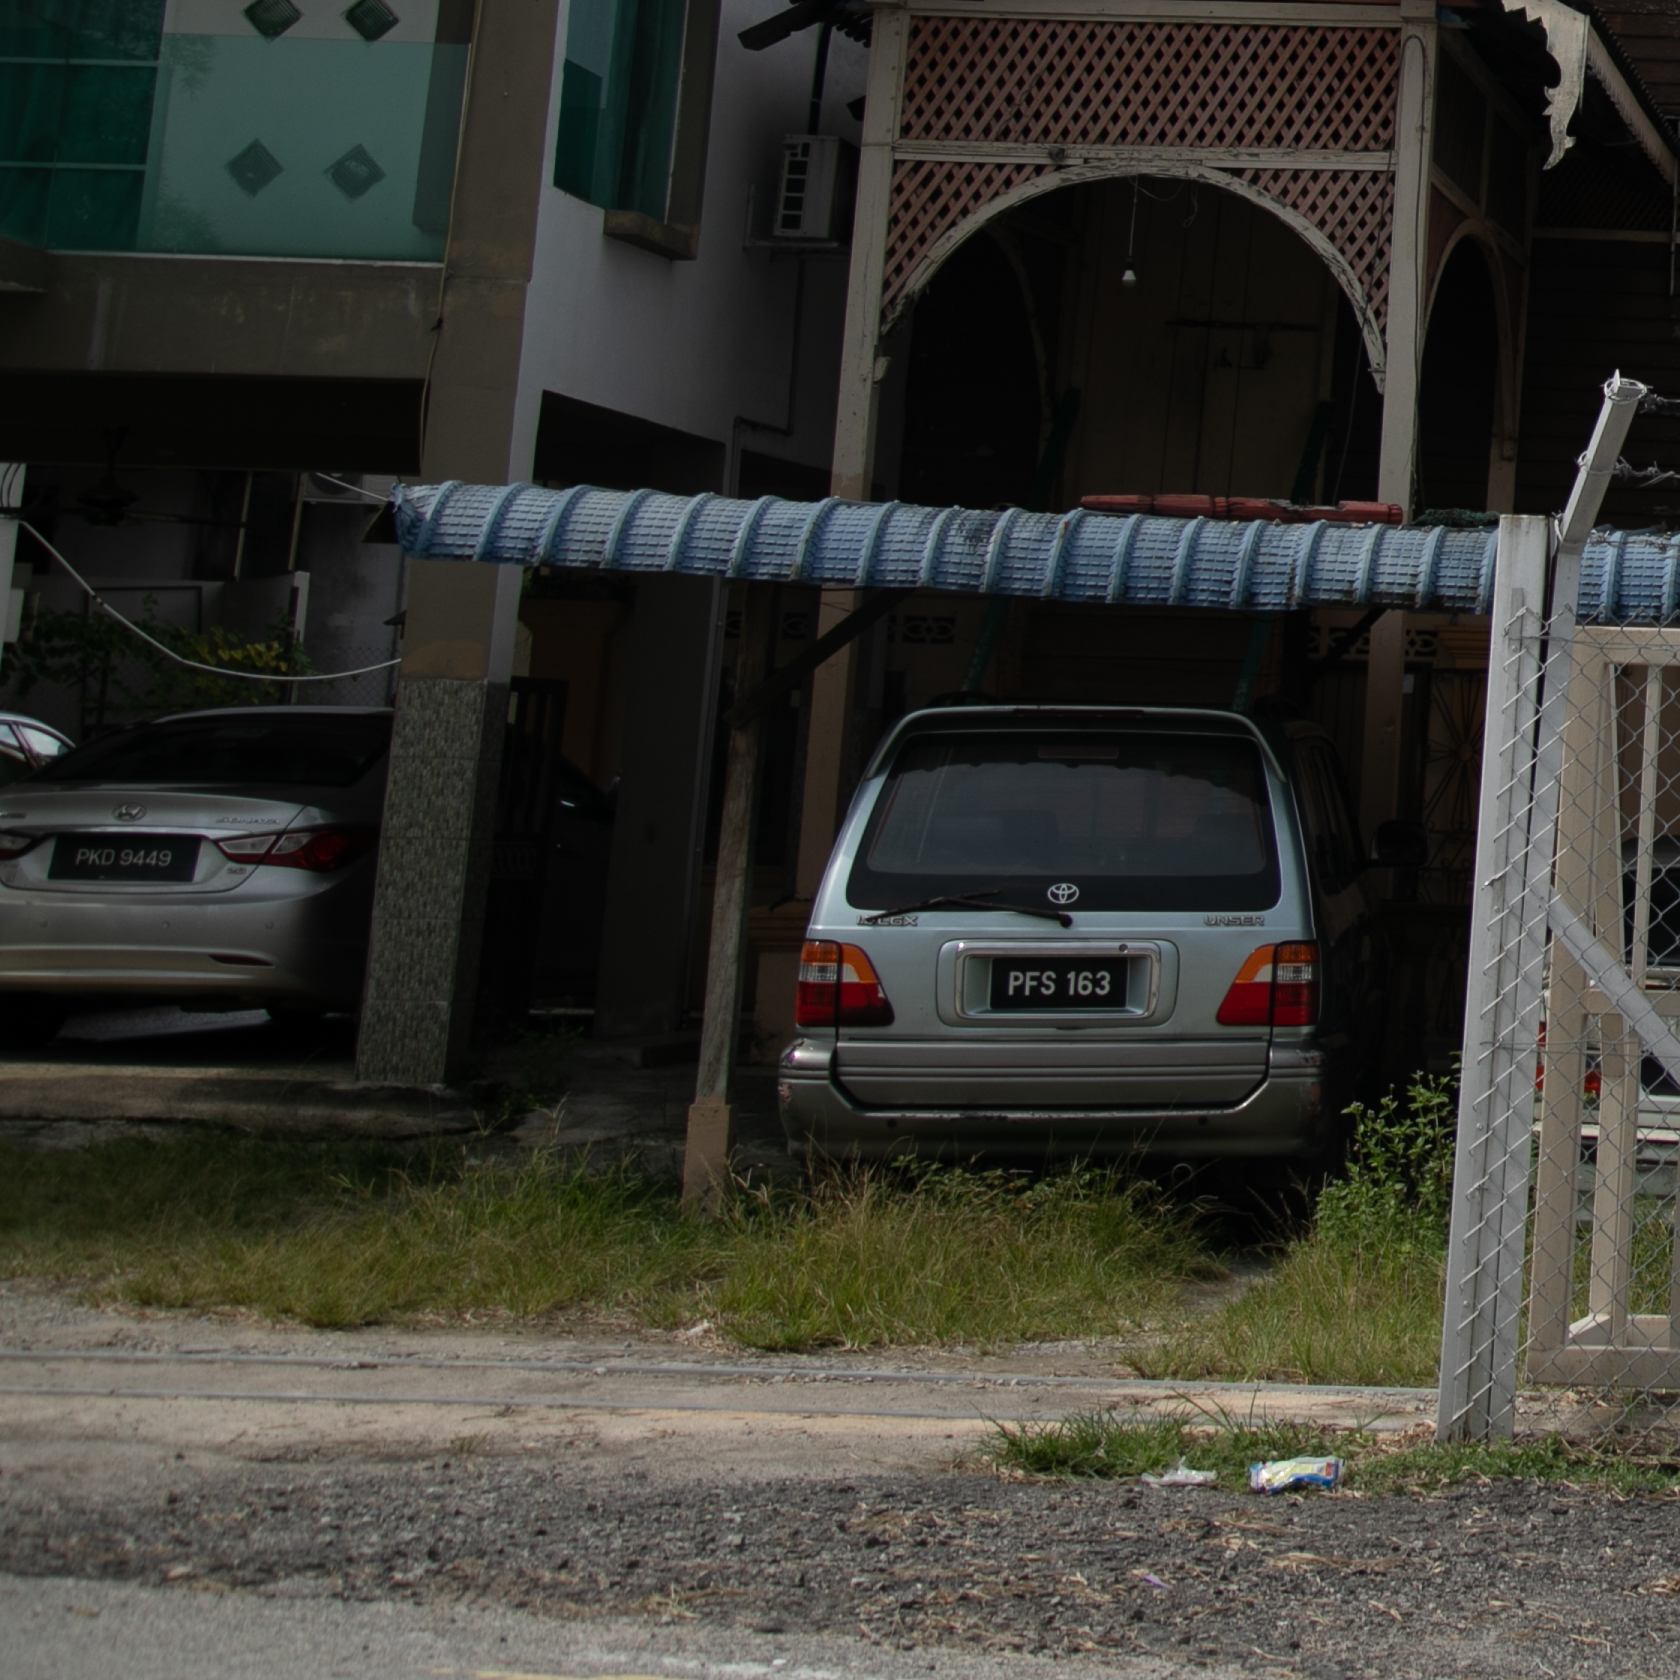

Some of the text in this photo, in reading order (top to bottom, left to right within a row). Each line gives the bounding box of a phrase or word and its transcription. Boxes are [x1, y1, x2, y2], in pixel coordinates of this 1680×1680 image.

[75, 848, 173, 867] PKD 9449
[1203, 913, 1265, 928] UNSER
[1006, 969, 1111, 998] PFS 163
